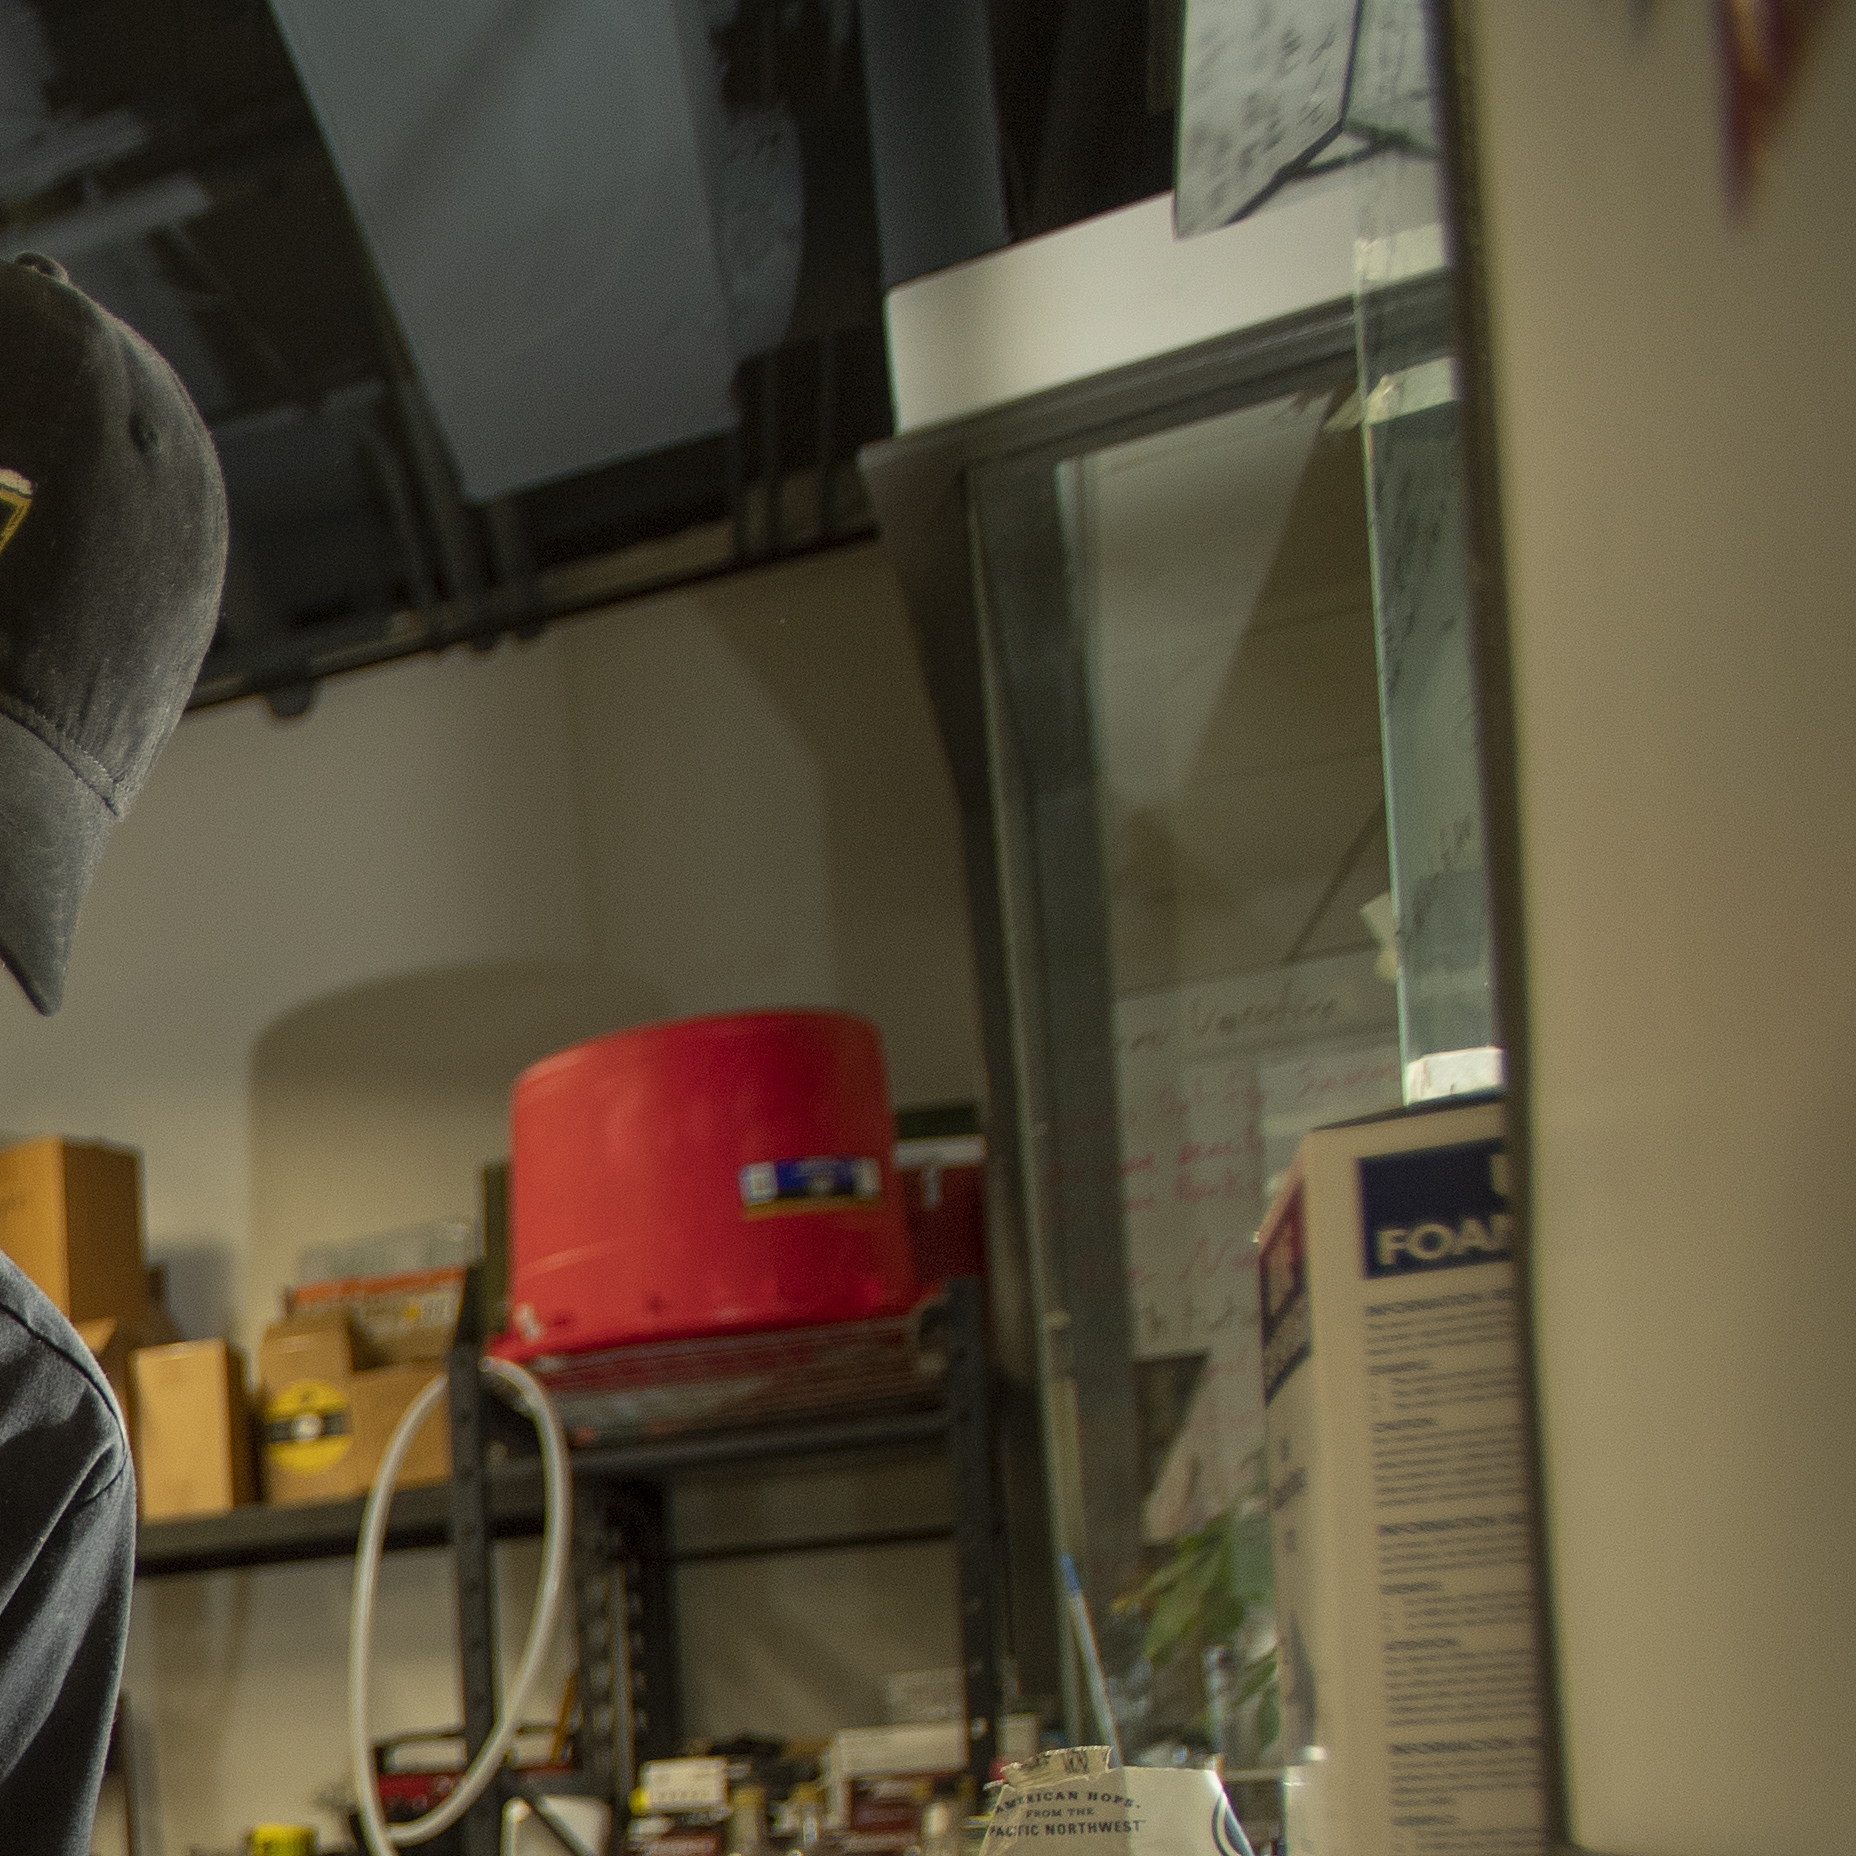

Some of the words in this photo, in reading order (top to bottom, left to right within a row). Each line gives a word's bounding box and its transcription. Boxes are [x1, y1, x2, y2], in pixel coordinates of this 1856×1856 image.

[1026, 1807, 1062, 1818] FROM
[1068, 1807, 1094, 1817] THE
[1045, 1820, 1140, 1836] NORTHWEST
